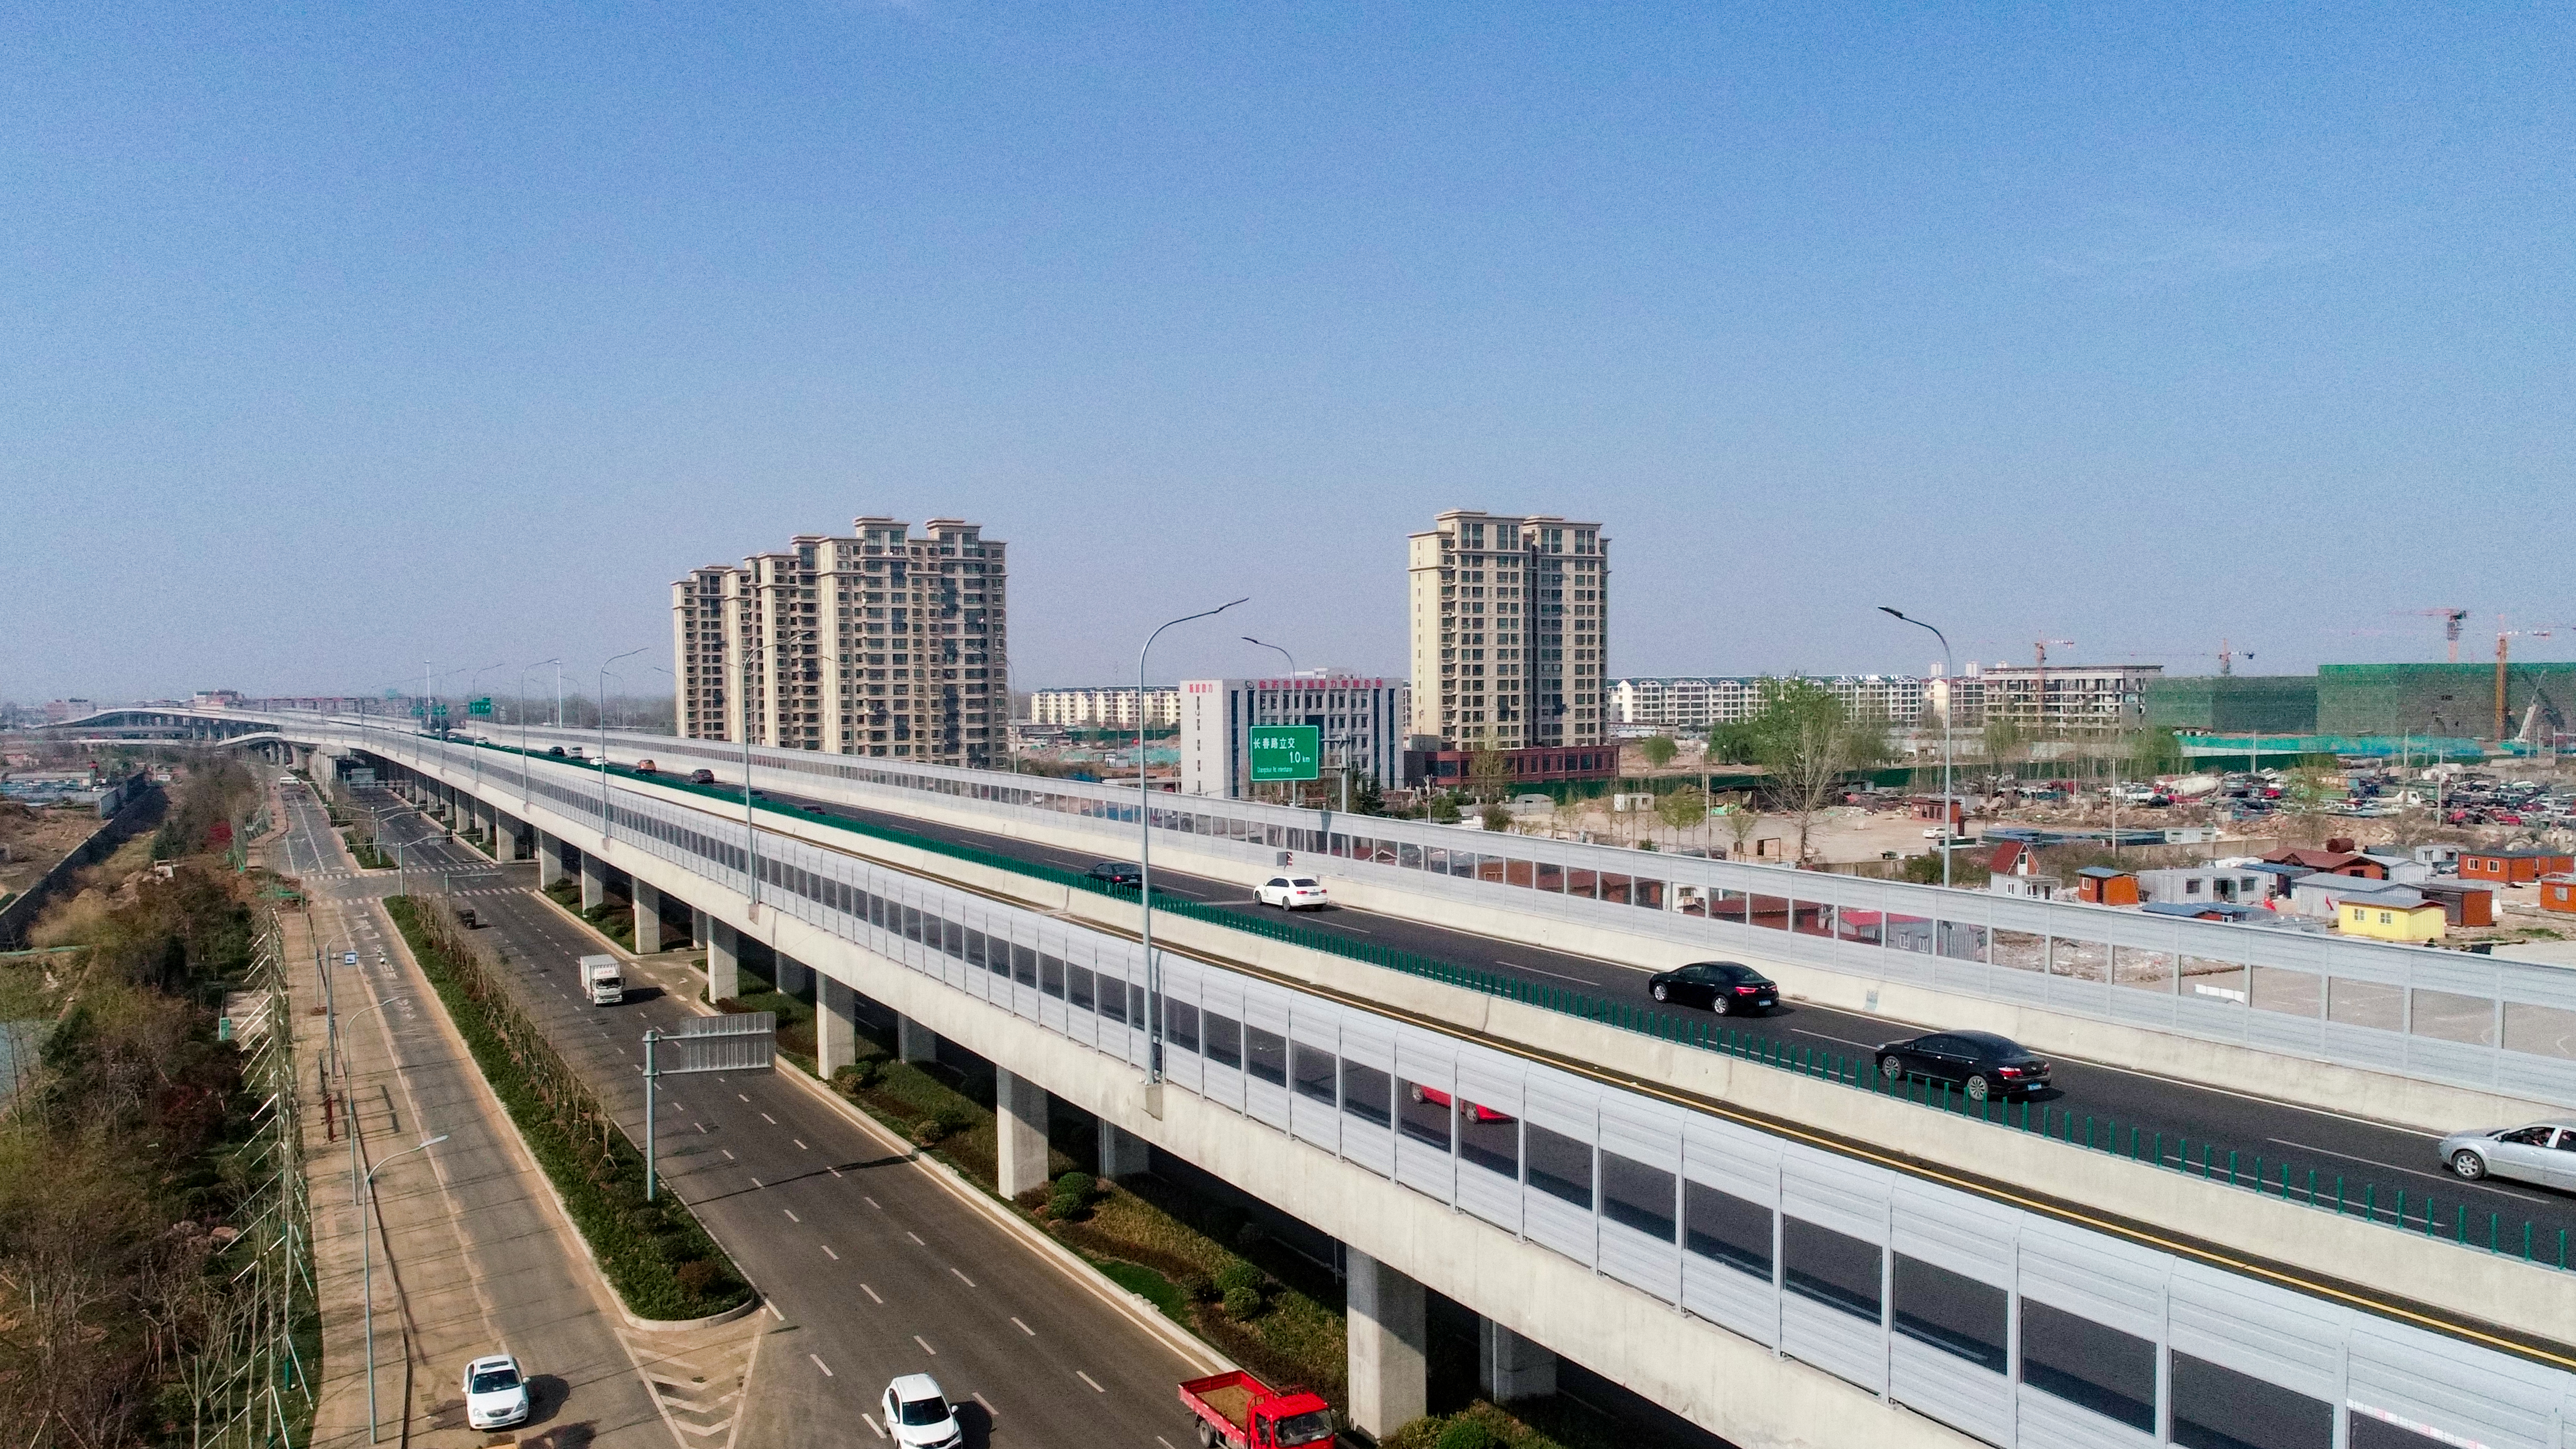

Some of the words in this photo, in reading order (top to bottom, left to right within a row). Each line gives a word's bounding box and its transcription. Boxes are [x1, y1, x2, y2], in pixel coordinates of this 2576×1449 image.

[1253, 737, 1295, 749] 长春路立交
